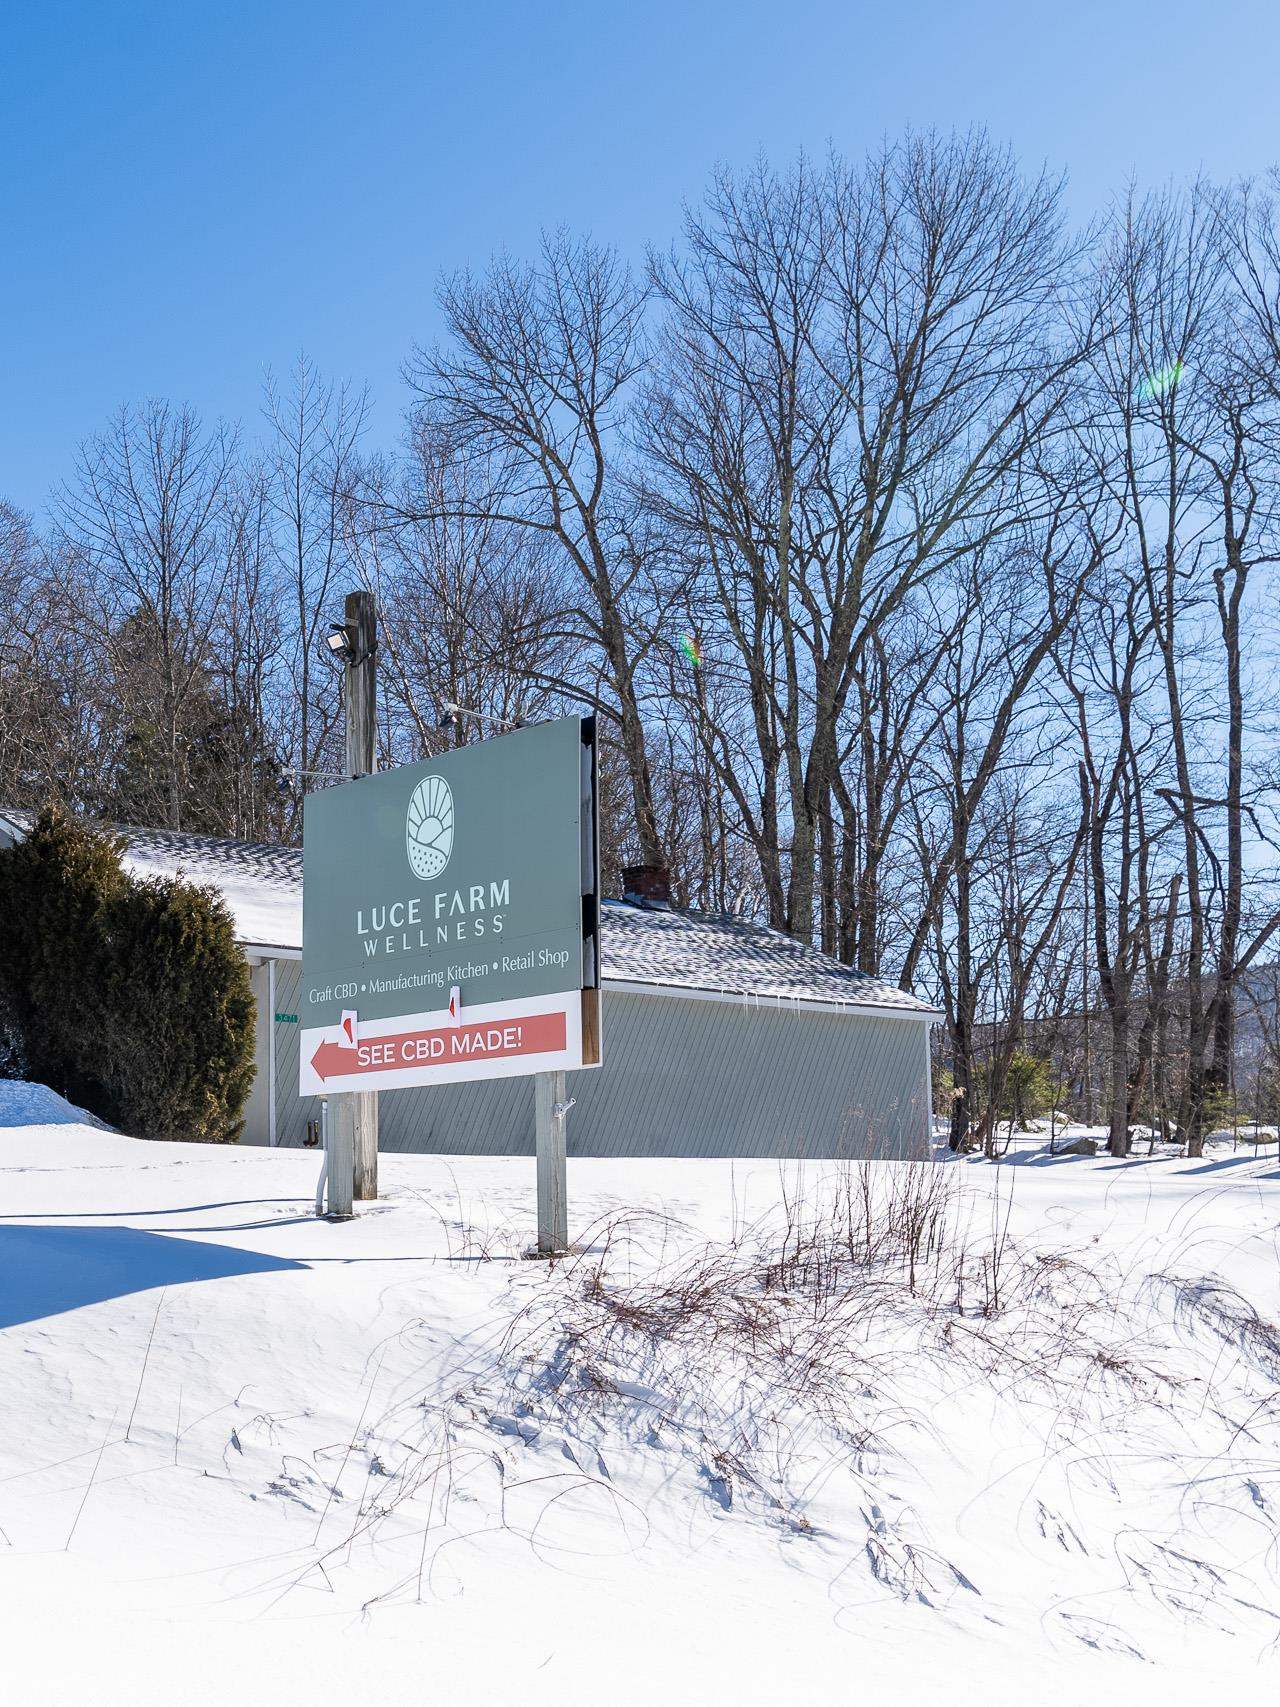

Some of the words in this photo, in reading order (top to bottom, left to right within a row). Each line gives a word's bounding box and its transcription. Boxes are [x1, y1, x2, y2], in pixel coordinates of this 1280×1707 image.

[357, 898, 422, 934] LUCE
[434, 879, 510, 919] FARM
[364, 914, 504, 957] WELLNESS
[309, 986, 332, 1003] Craft
[334, 982, 358, 999] CBD
[369, 969, 444, 994] Manufacturing
[447, 961, 489, 982] Kitchen
[502, 950, 535, 973] Retail
[538, 948, 569, 968] Shop
[357, 1043, 395, 1067] SEE
[401, 1037, 445, 1061] CBD
[451, 1026, 522, 1055] MADE!
